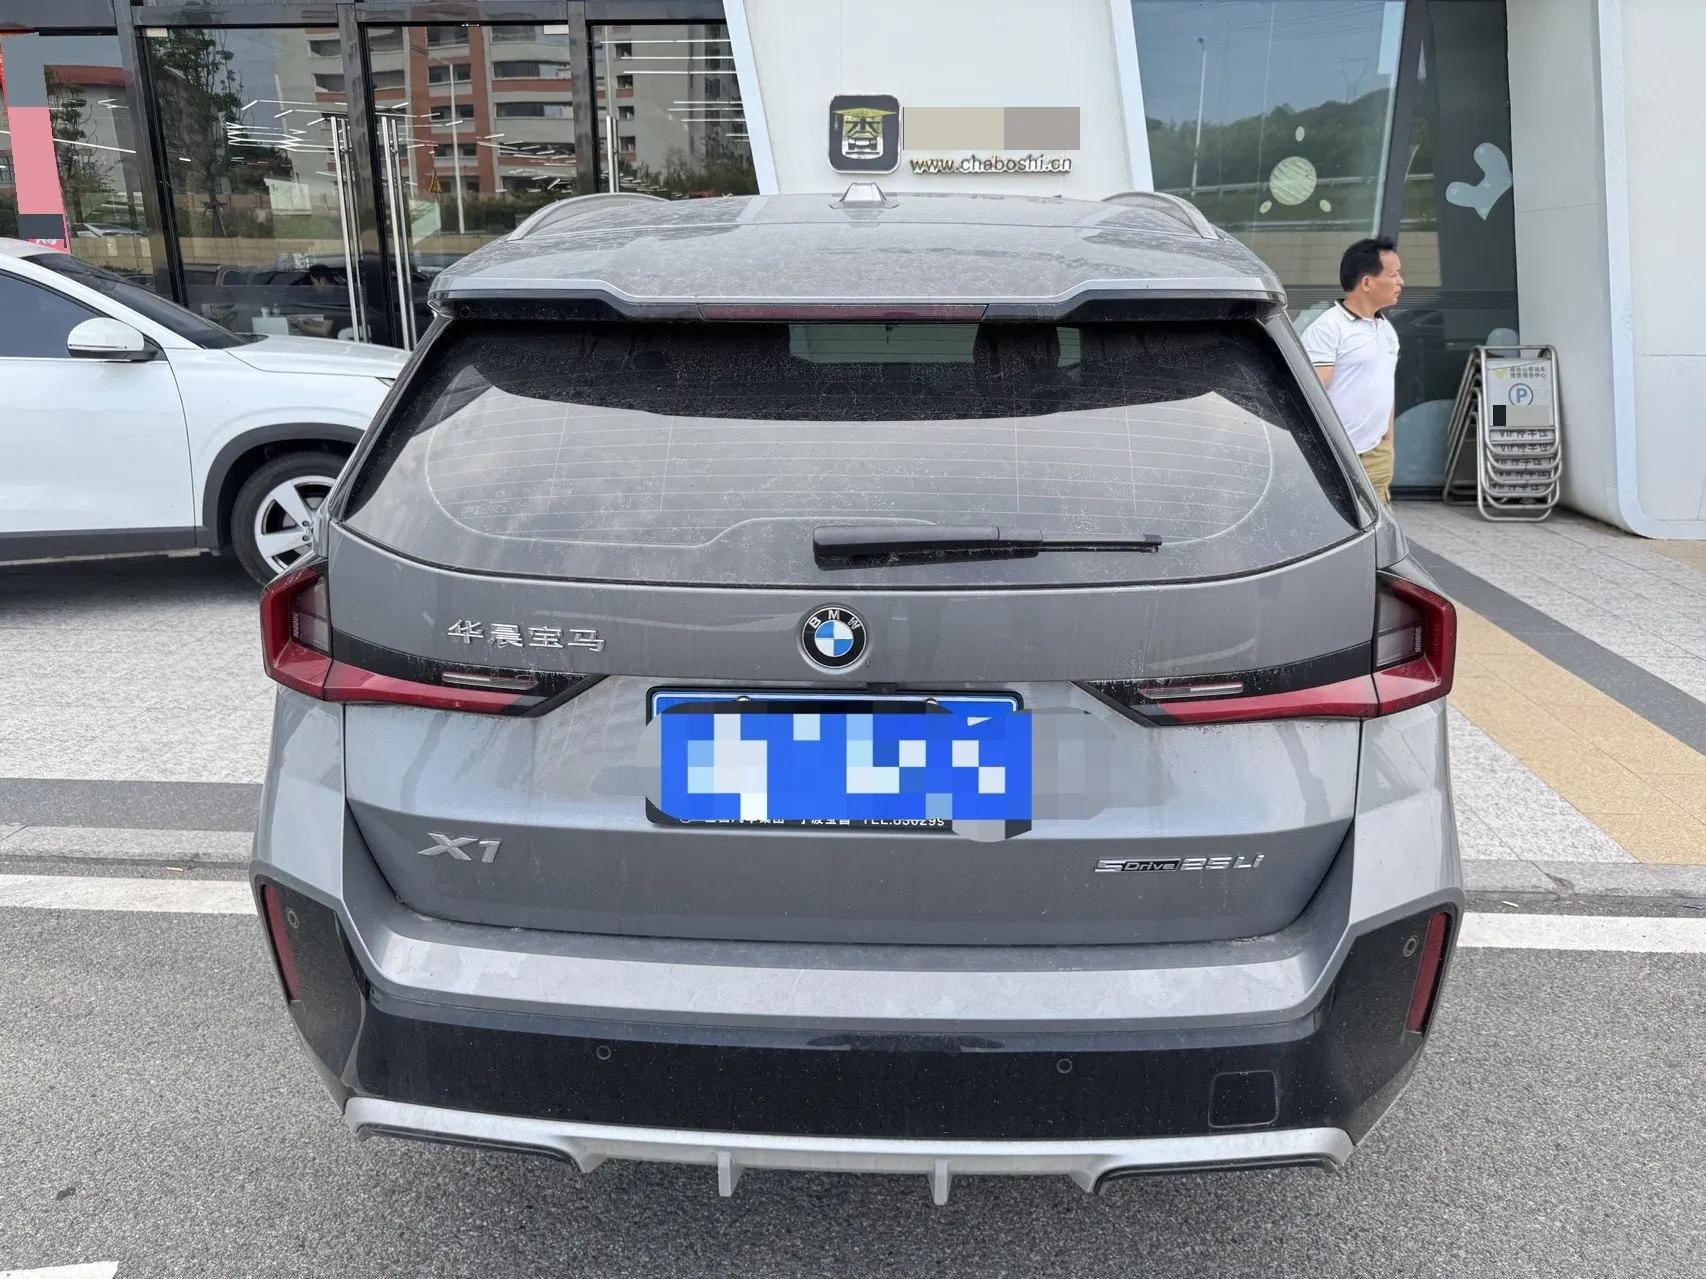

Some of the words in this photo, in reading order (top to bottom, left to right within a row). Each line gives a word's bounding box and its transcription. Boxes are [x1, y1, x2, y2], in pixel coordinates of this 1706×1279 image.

[910, 154, 1072, 174] www.chaboshi.cn
[1516, 388, 1527, 403] P
[808, 609, 861, 630] BMW
[447, 619, 605, 652] 华晨宝马
[417, 832, 501, 863] X1
